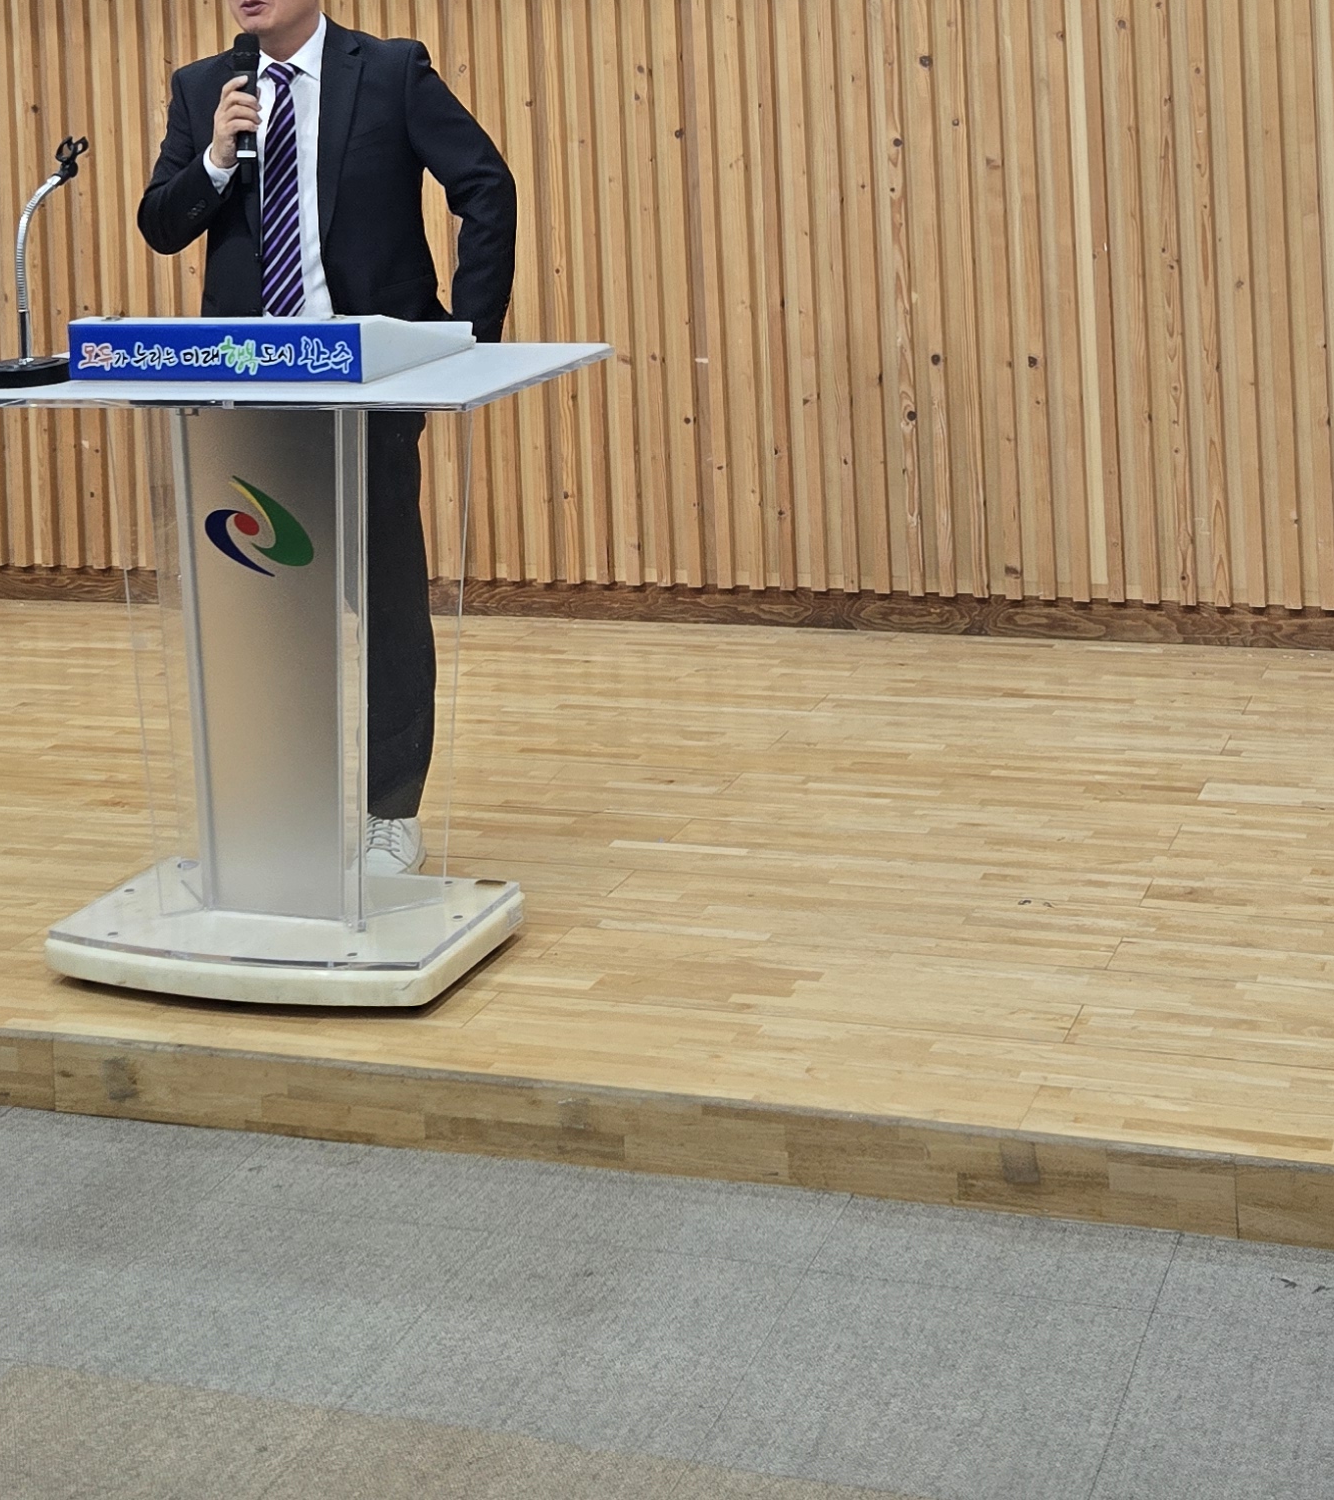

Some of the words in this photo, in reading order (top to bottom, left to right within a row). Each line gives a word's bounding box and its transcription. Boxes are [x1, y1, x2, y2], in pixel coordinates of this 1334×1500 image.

[78, 342, 129, 371] 모두가
[131, 341, 178, 371] 누리는
[298, 336, 354, 374] 완주
